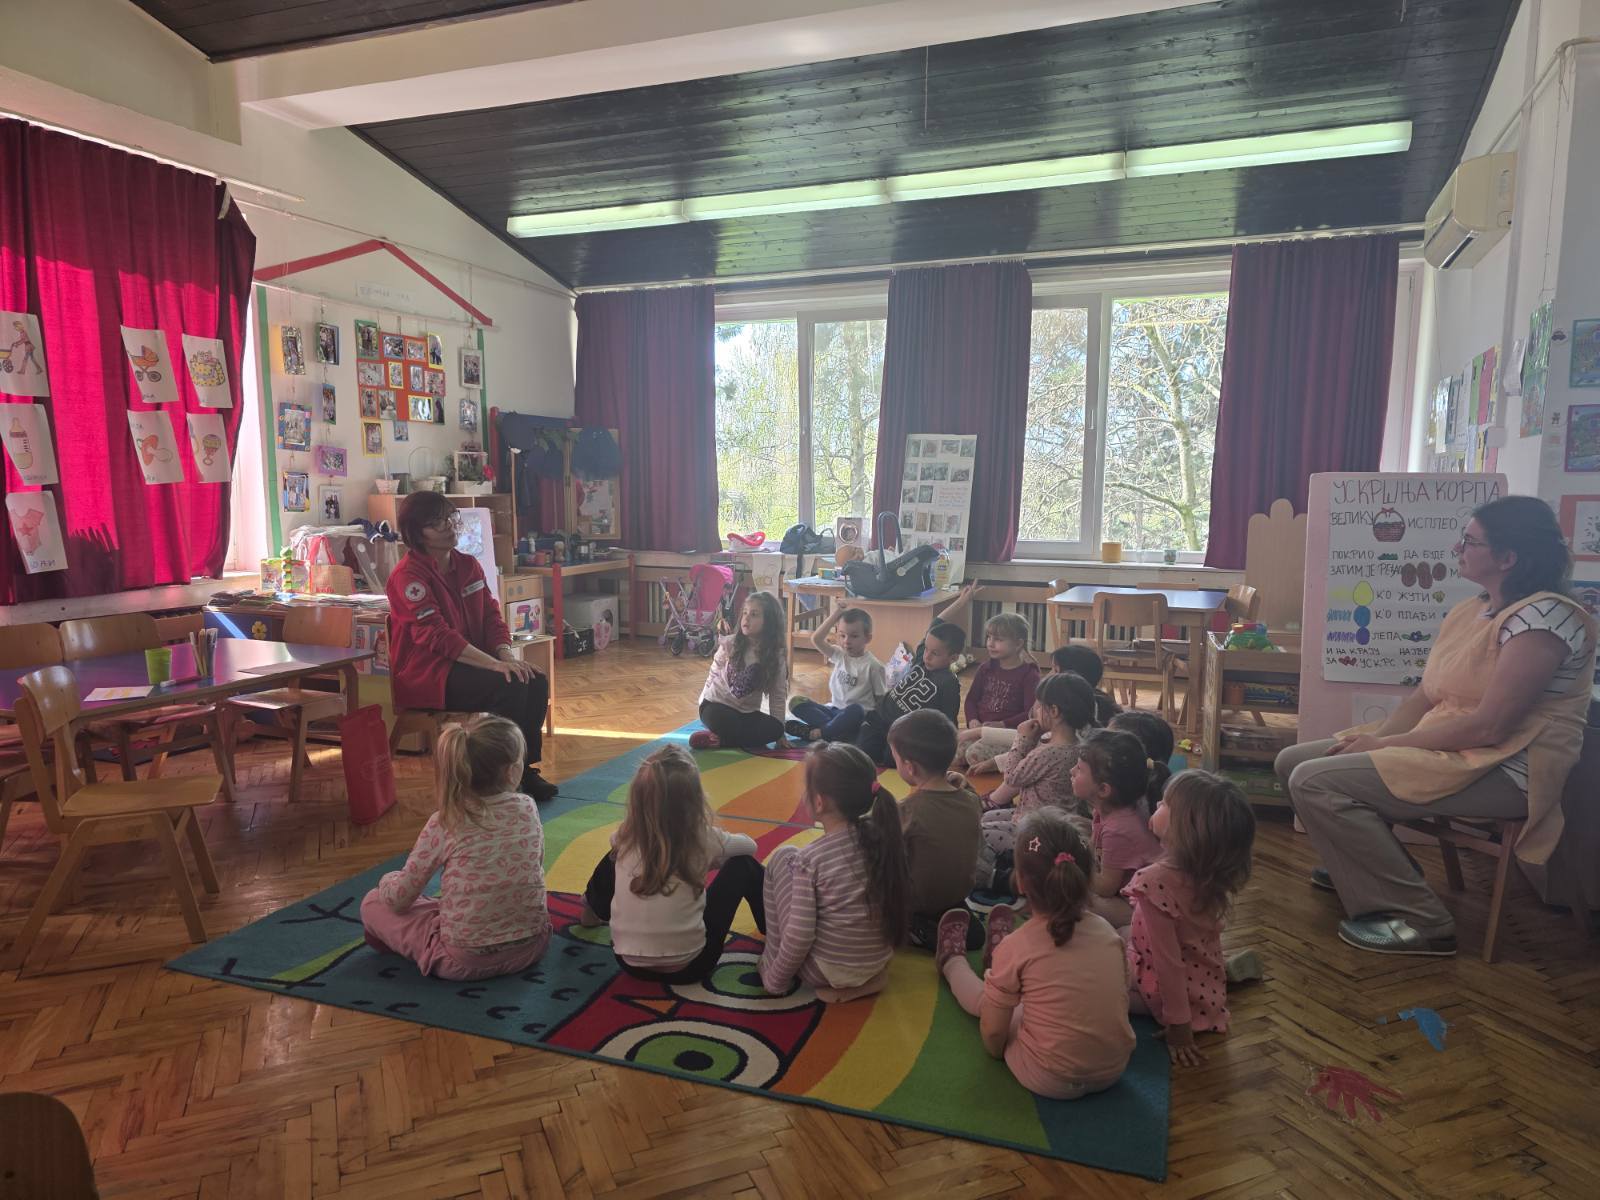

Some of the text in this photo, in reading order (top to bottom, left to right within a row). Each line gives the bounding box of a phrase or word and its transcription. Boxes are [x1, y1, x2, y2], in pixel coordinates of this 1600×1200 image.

[1333, 479, 1500, 505] УСКРШЊА КОРПА
[1331, 511, 1458, 530] ВЕЛИКУ ИСПЛЕО
[1332, 549, 1375, 560] ПОКРИО
[1404, 550, 1418, 560] ДА
[1423, 550, 1445, 560] БУДЕ
[1330, 564, 1362, 577] ЗАТИМ
[1398, 590, 1430, 603] ЖУТИ
[1398, 610, 1436, 621] ПЛАВИ
[1371, 632, 1401, 641] ЛЕПА
[1336, 647, 1346, 655] НА
[1326, 657, 1338, 665] ЗА
